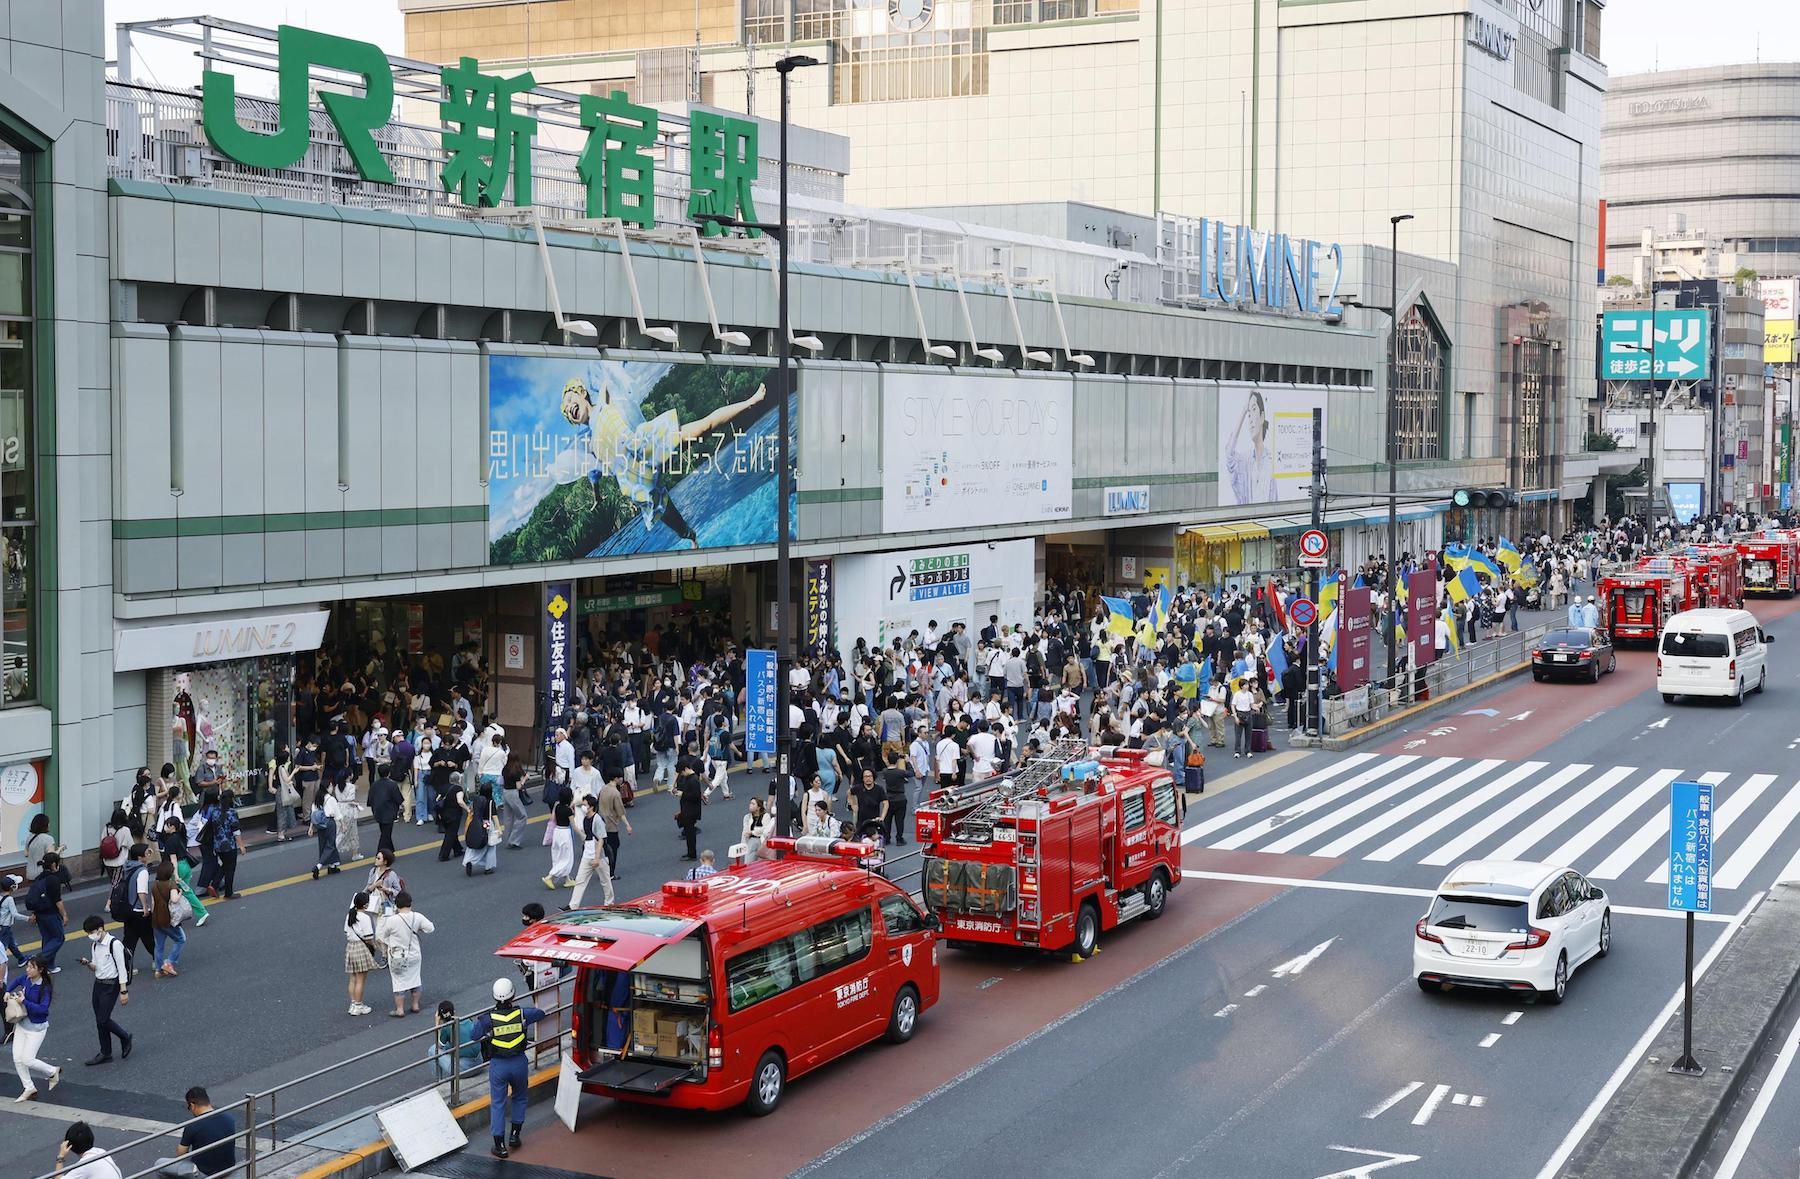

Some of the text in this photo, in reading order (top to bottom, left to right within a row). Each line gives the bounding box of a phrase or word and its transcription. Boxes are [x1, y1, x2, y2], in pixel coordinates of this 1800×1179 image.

[203, 25, 758, 238] JR 新宿駅
[1200, 217, 1344, 314] LUMINE 2
[1610, 319, 1700, 353] ニトリ
[1610, 359, 1664, 374] 徒歩2分
[904, 396, 1059, 436] STYLE YOUR DAYS
[819, 564, 828, 653] すみふの仲介
[919, 583, 967, 599] VIEW ALTTE
[809, 579, 818, 646] ステップ
[193, 622, 297, 657] LUMINE 2
[757, 670, 767, 734] バスタ新宿へは
[748, 705, 758, 749] 入れません
[1684, 808, 1698, 886] バスタ新宿へは
[1671, 852, 1684, 907] 入れません
[957, 919, 1002, 933] 東京消防庁
[531, 948, 597, 963] 東京消防庁
[1465, 943, 1488, 955] 22-10
[836, 977, 869, 1001] 東京消防庁
